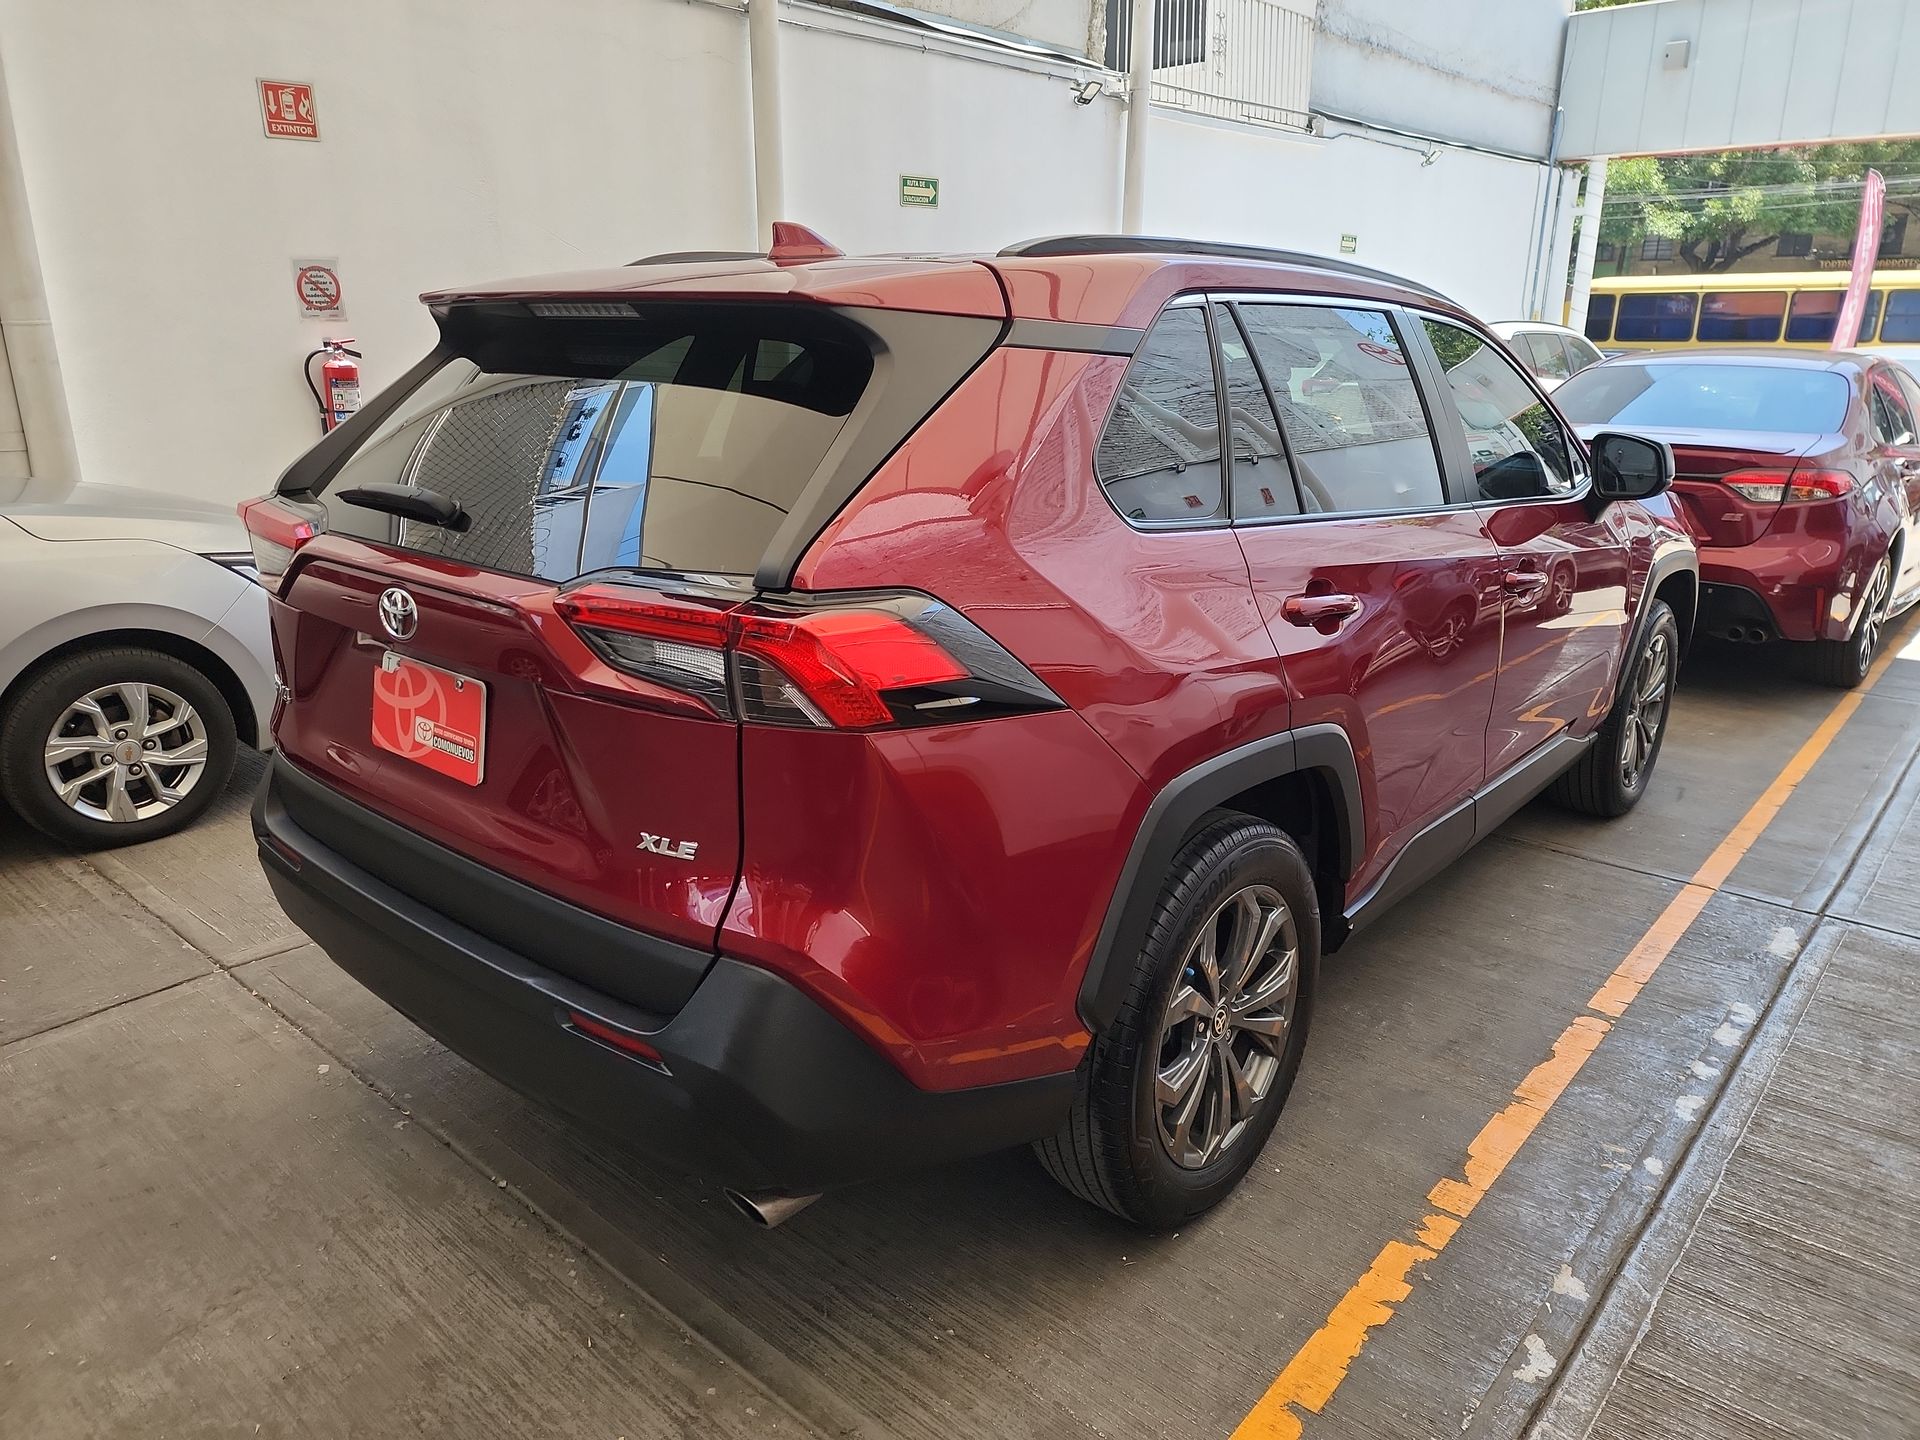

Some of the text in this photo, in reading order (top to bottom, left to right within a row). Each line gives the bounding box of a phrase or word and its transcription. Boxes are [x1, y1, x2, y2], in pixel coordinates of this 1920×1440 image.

[271, 123, 313, 135] EXTINTOR
[433, 736, 474, 761] COMONUEVOS
[636, 832, 699, 861] XLE
